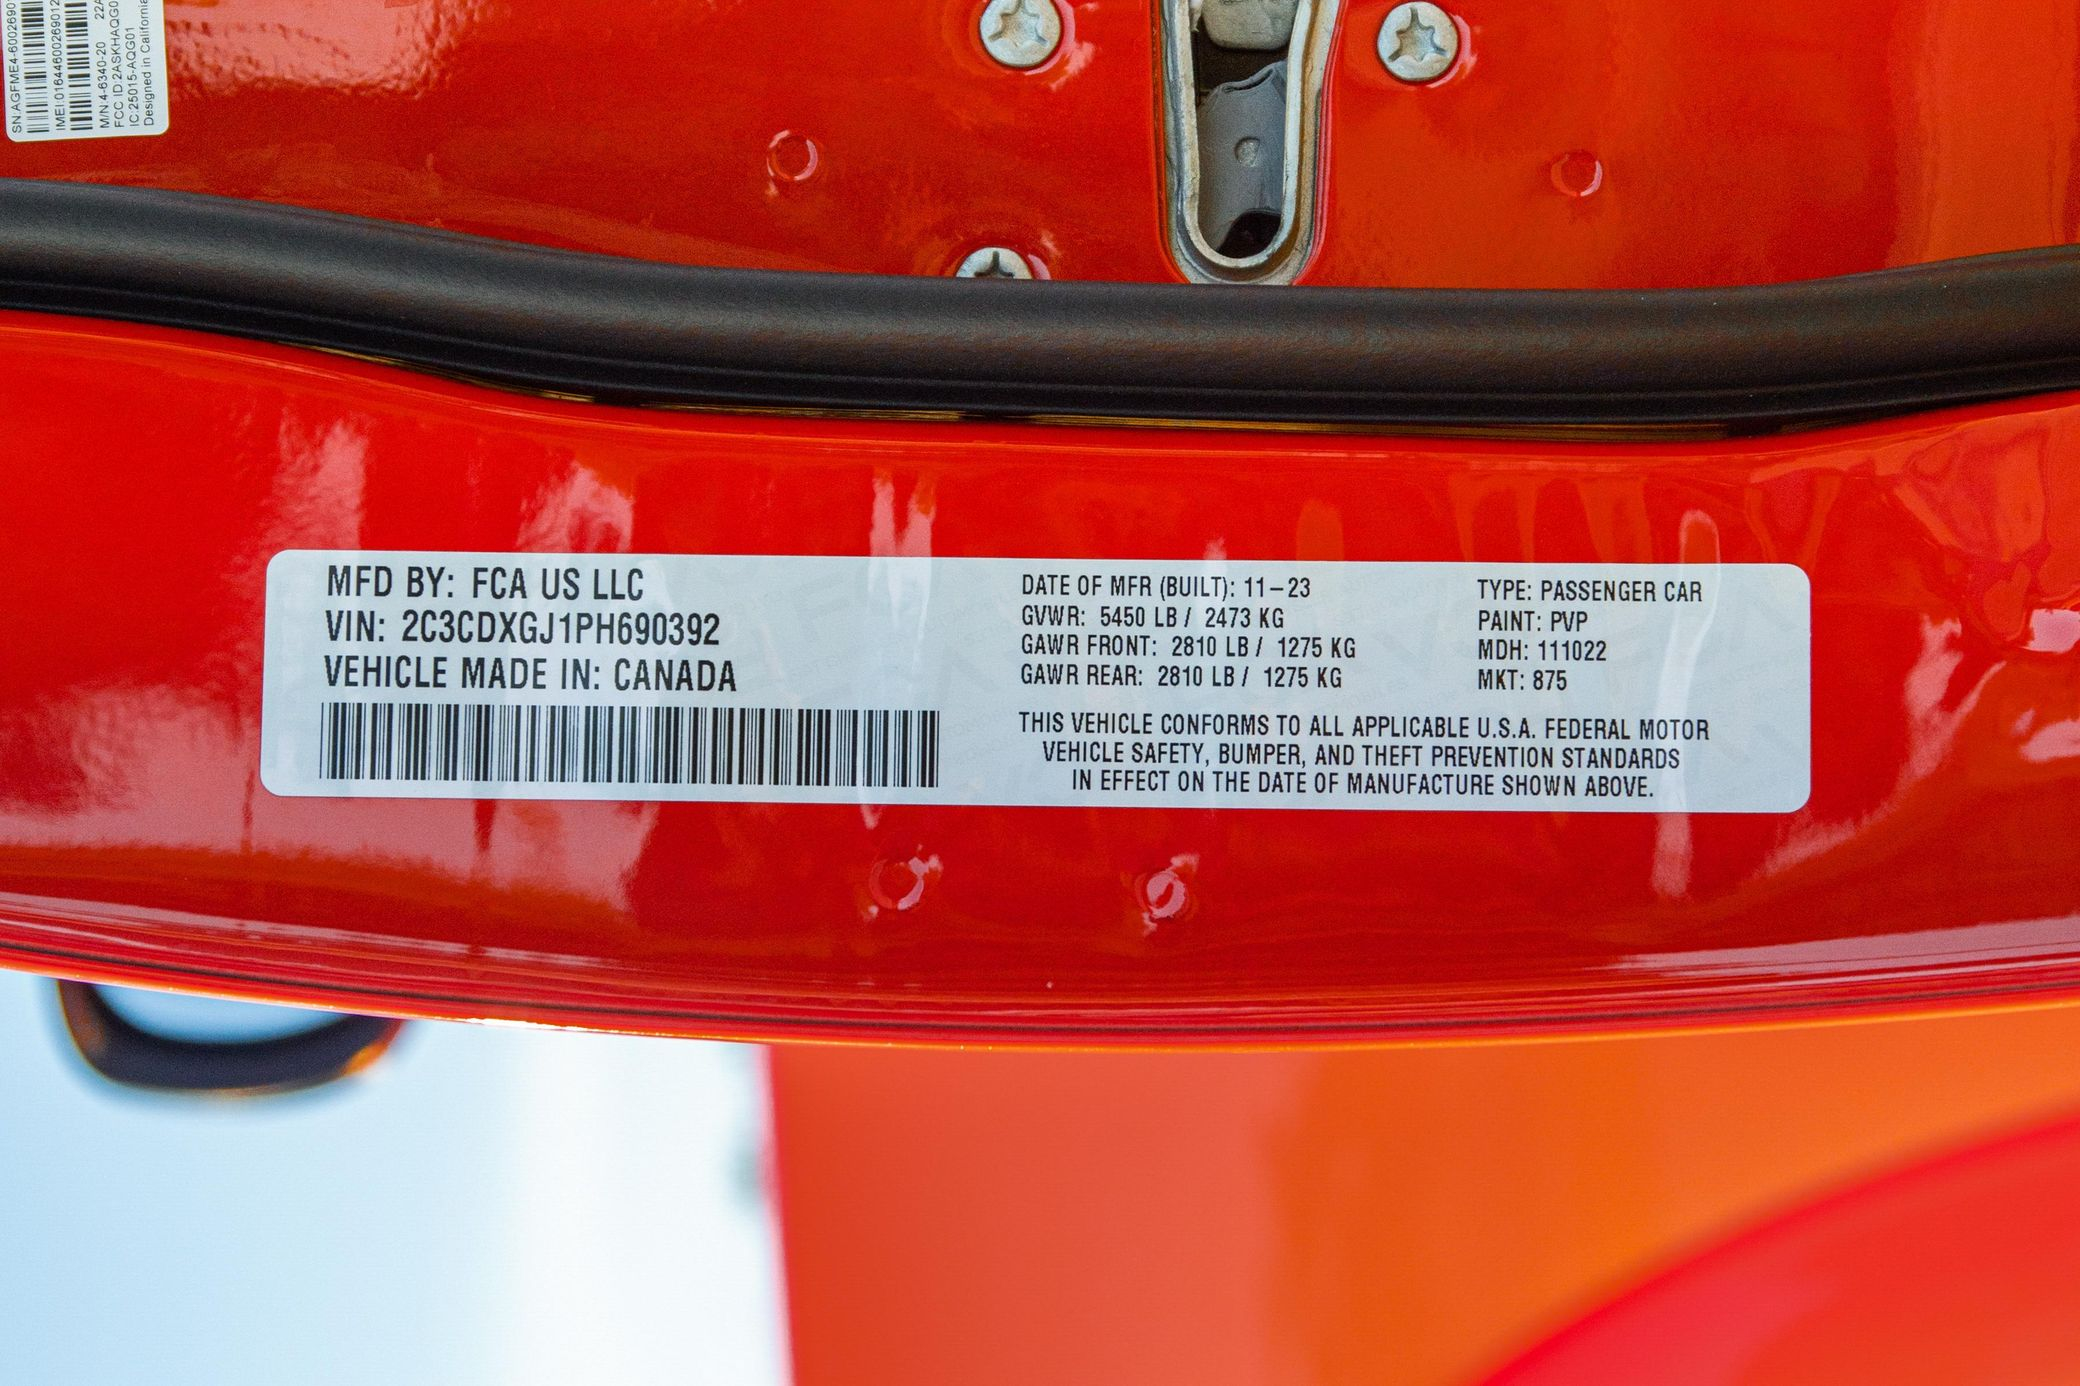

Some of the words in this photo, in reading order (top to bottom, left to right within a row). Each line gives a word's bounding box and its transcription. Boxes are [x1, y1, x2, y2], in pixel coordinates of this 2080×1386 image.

[138, 0, 150, 53] California
[6, 0, 22, 133] SN:AGFME4-6002690
[125, 27, 140, 126] IC:25015-AQG01
[141, 57, 150, 69] in
[96, 41, 110, 129] M/N:4-6340-20
[143, 72, 155, 126] Designed
[114, 102, 124, 128] FCC
[328, 565, 392, 597] MFD
[407, 566, 453, 597] BY:
[473, 567, 527, 599] FCA
[542, 568, 580, 600] US
[594, 568, 643, 601] LLC
[1023, 574, 1070, 595] DATE
[1078, 575, 1102, 596] OF
[1111, 576, 1152, 596] MFR
[1160, 576, 1234, 602] (BUILT):
[1477, 579, 1531, 600] TYPE:
[1542, 580, 1656, 602] PASSENGER
[1665, 581, 1702, 602] CAR
[326, 610, 384, 642] VIN:
[402, 609, 720, 646] 2C3CDXGJ1PH690392
[1022, 605, 1085, 626] GVWR:
[1101, 606, 1145, 627] 5450
[1155, 607, 1177, 627] LB
[1206, 607, 1250, 628] 2473
[1260, 608, 1283, 628] KG
[1479, 610, 1540, 631] PAINT:
[1551, 611, 1588, 632] PVP
[1022, 634, 1079, 655] GAWR
[1088, 635, 1156, 656] FRONT:
[1172, 636, 1216, 656] 2810
[1227, 636, 1248, 657] LB
[1278, 637, 1322, 658] 1275
[1332, 637, 1355, 658] KG
[1479, 639, 1528, 660] MDH:
[1538, 640, 1606, 661] 111022
[324, 655, 447, 688] VEHICLE
[462, 657, 546, 689] MADE
[562, 659, 599, 690] IN:
[615, 658, 736, 692] CANADA
[1021, 663, 1078, 685] GAWR
[1087, 664, 1142, 686] REAR:
[1158, 665, 1202, 686] 2810
[1213, 666, 1234, 687] LB
[1264, 667, 1308, 687] 1275
[1318, 667, 1341, 688] KG
[1479, 669, 1524, 690] MKT:
[1533, 670, 1567, 691] 875
[1019, 712, 1063, 733] THIS
[1071, 712, 1152, 734] VEHICLE
[1161, 714, 1269, 735] CONFORMS
[1276, 715, 1300, 736] TO
[1309, 715, 1344, 736] ALL
[1352, 716, 1469, 738] APPLICABLE
[1478, 717, 1535, 738] U.S.A.
[1546, 718, 1630, 739] FEDERAL
[1640, 719, 1709, 740] MOTOR
[1043, 741, 1124, 762] VEHICLE
[1132, 742, 1209, 767] SAFETY,
[1219, 743, 1305, 768] BUMPER,
[1315, 744, 1354, 765] AND
[1362, 745, 1423, 766] THEFT
[1432, 746, 1553, 768] PREVENTION
[1562, 747, 1679, 769] STANDARDS
[1073, 769, 1091, 790] IN
[1101, 770, 1170, 791] EFFECT
[1178, 771, 1204, 792] ON
[1212, 771, 1250, 792] THE
[1259, 772, 1306, 793] DATE
[1315, 772, 1338, 793] OF
[1348, 773, 1494, 795] MANUFACTURE
[1502, 775, 1575, 796] SHOWN
[1585, 776, 1653, 797] ABOVE.
